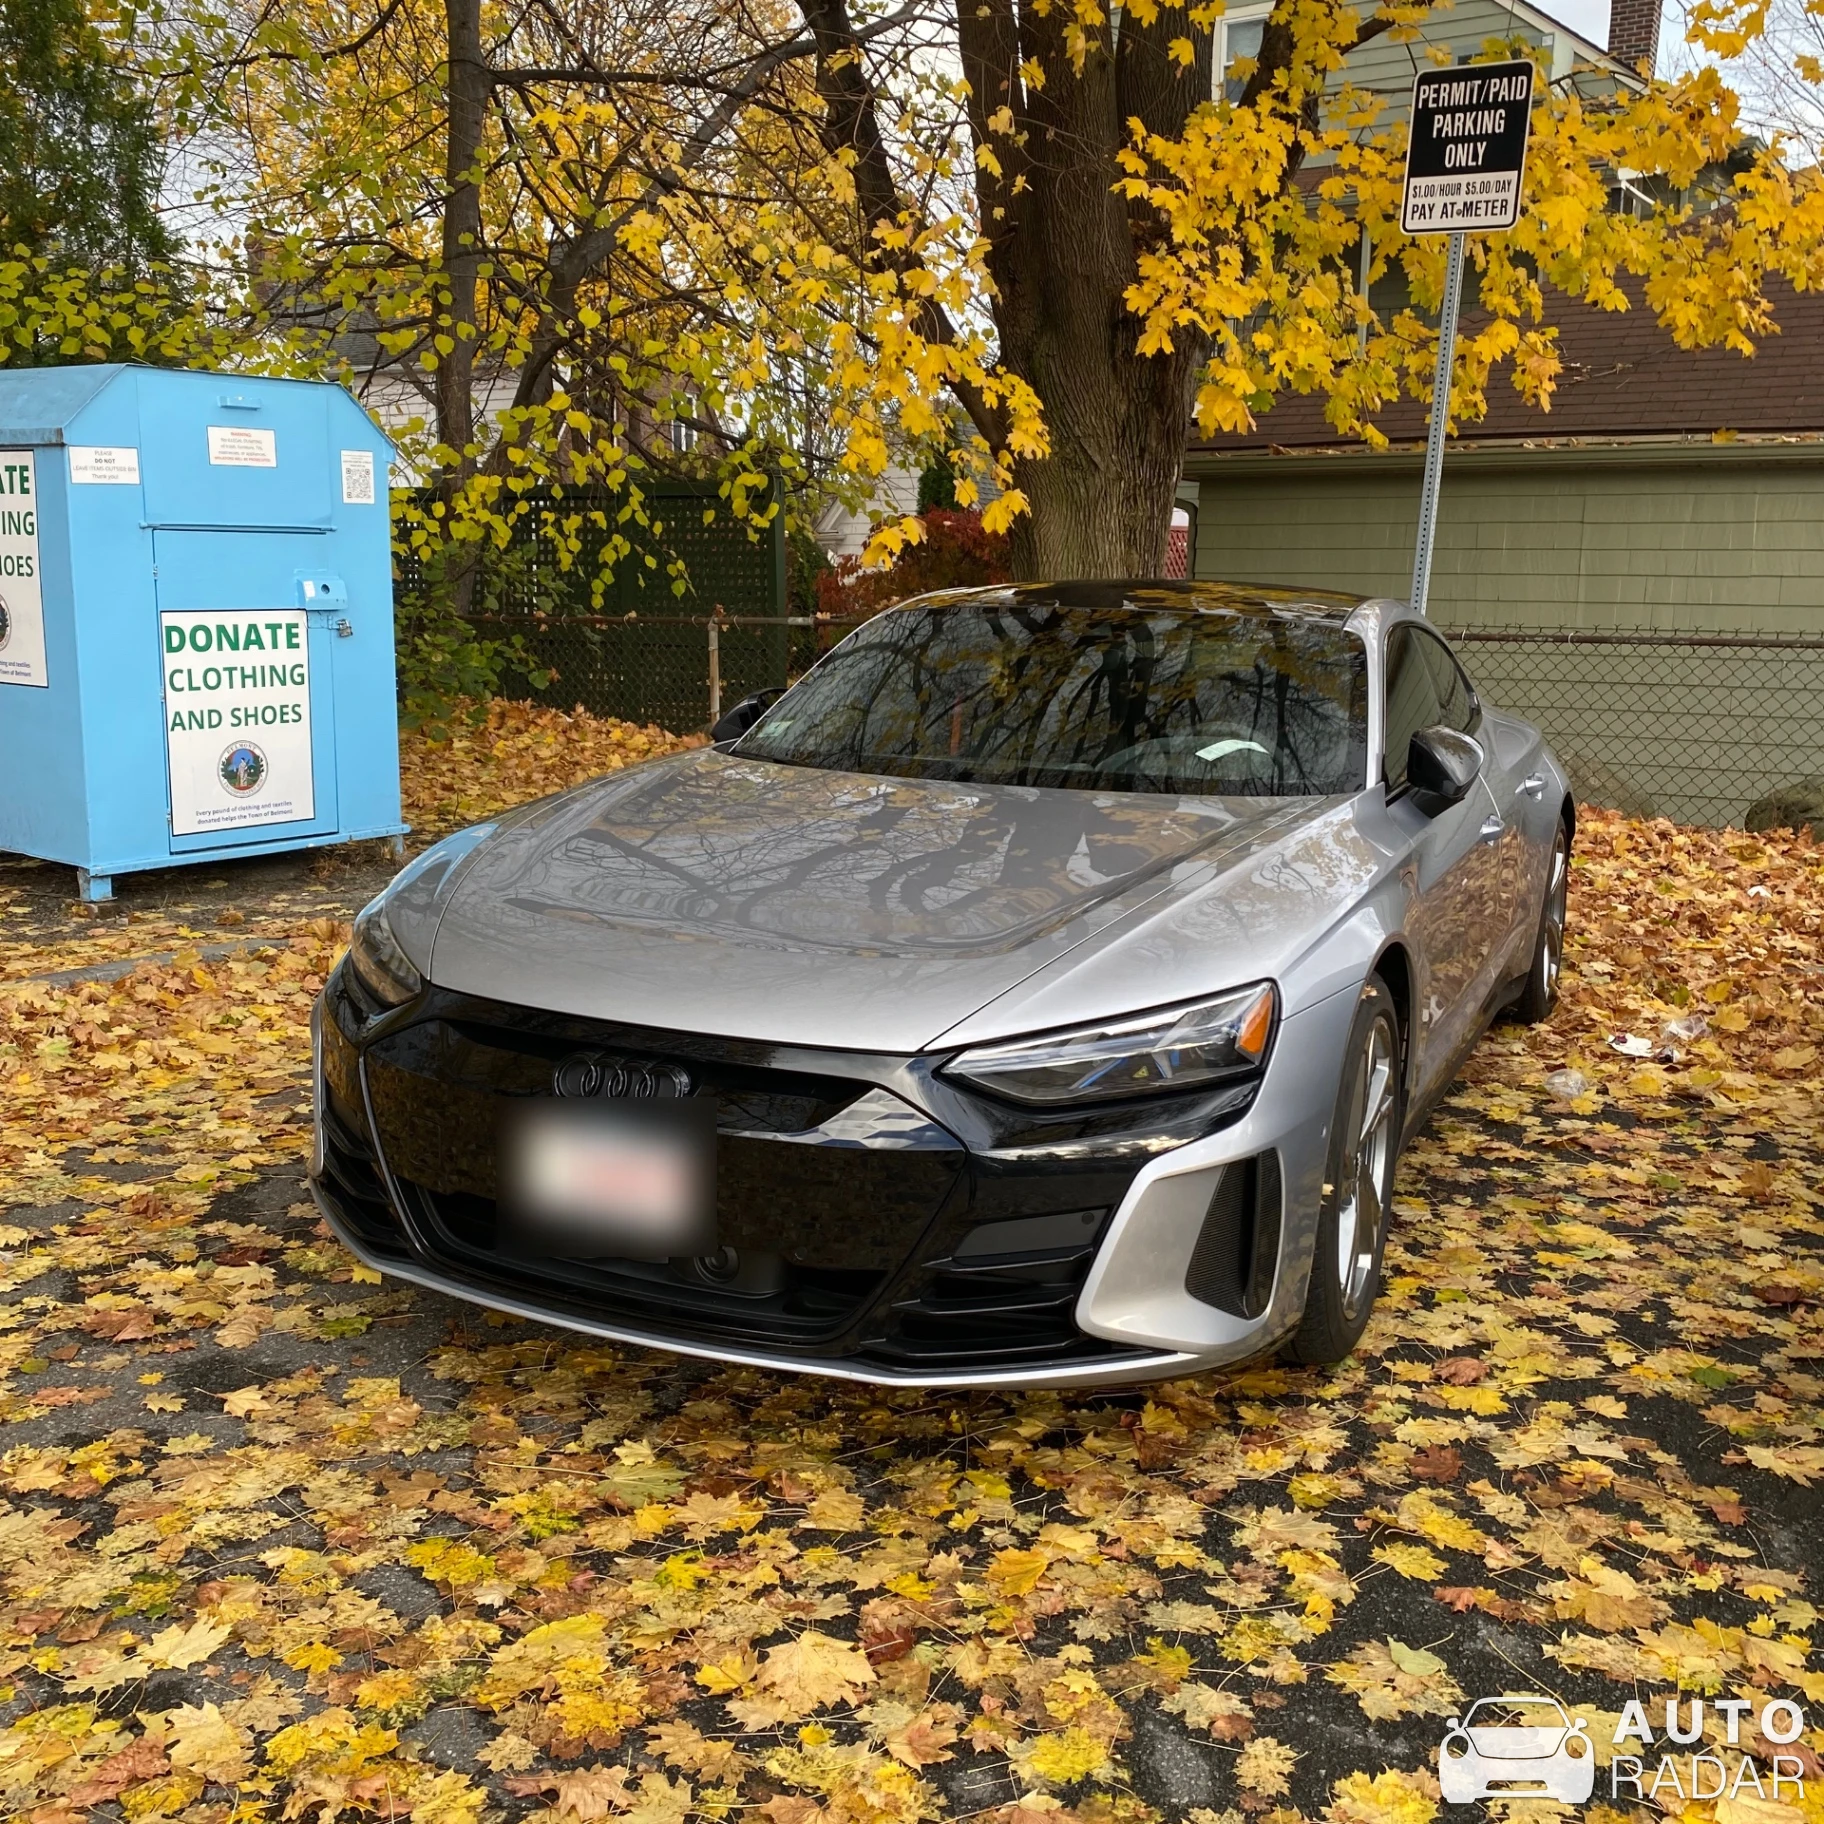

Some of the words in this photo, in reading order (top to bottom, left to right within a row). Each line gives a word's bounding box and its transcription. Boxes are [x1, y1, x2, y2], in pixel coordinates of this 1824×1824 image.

[1418, 75, 1528, 110] PERMIT/PAID
[1432, 109, 1506, 139] PARKING
[1444, 141, 1487, 168] ONLY
[1412, 182, 1462, 199] $1.00/HOUR
[1465, 179, 1512, 196] $5.00/DAY
[1411, 203, 1435, 221] PAY
[1440, 202, 1457, 220] AT
[1462, 199, 1508, 218] METER
[164, 622, 301, 654] DONATE
[168, 663, 305, 692] CLOTHING
[170, 709, 223, 732] AND
[230, 703, 302, 728] SHOES
[195, 809, 211, 817] Every
[212, 807, 230, 815] pound
[238, 803, 260, 812] clothing
[197, 817, 221, 825] donated
[221, 815, 237, 823] helps
